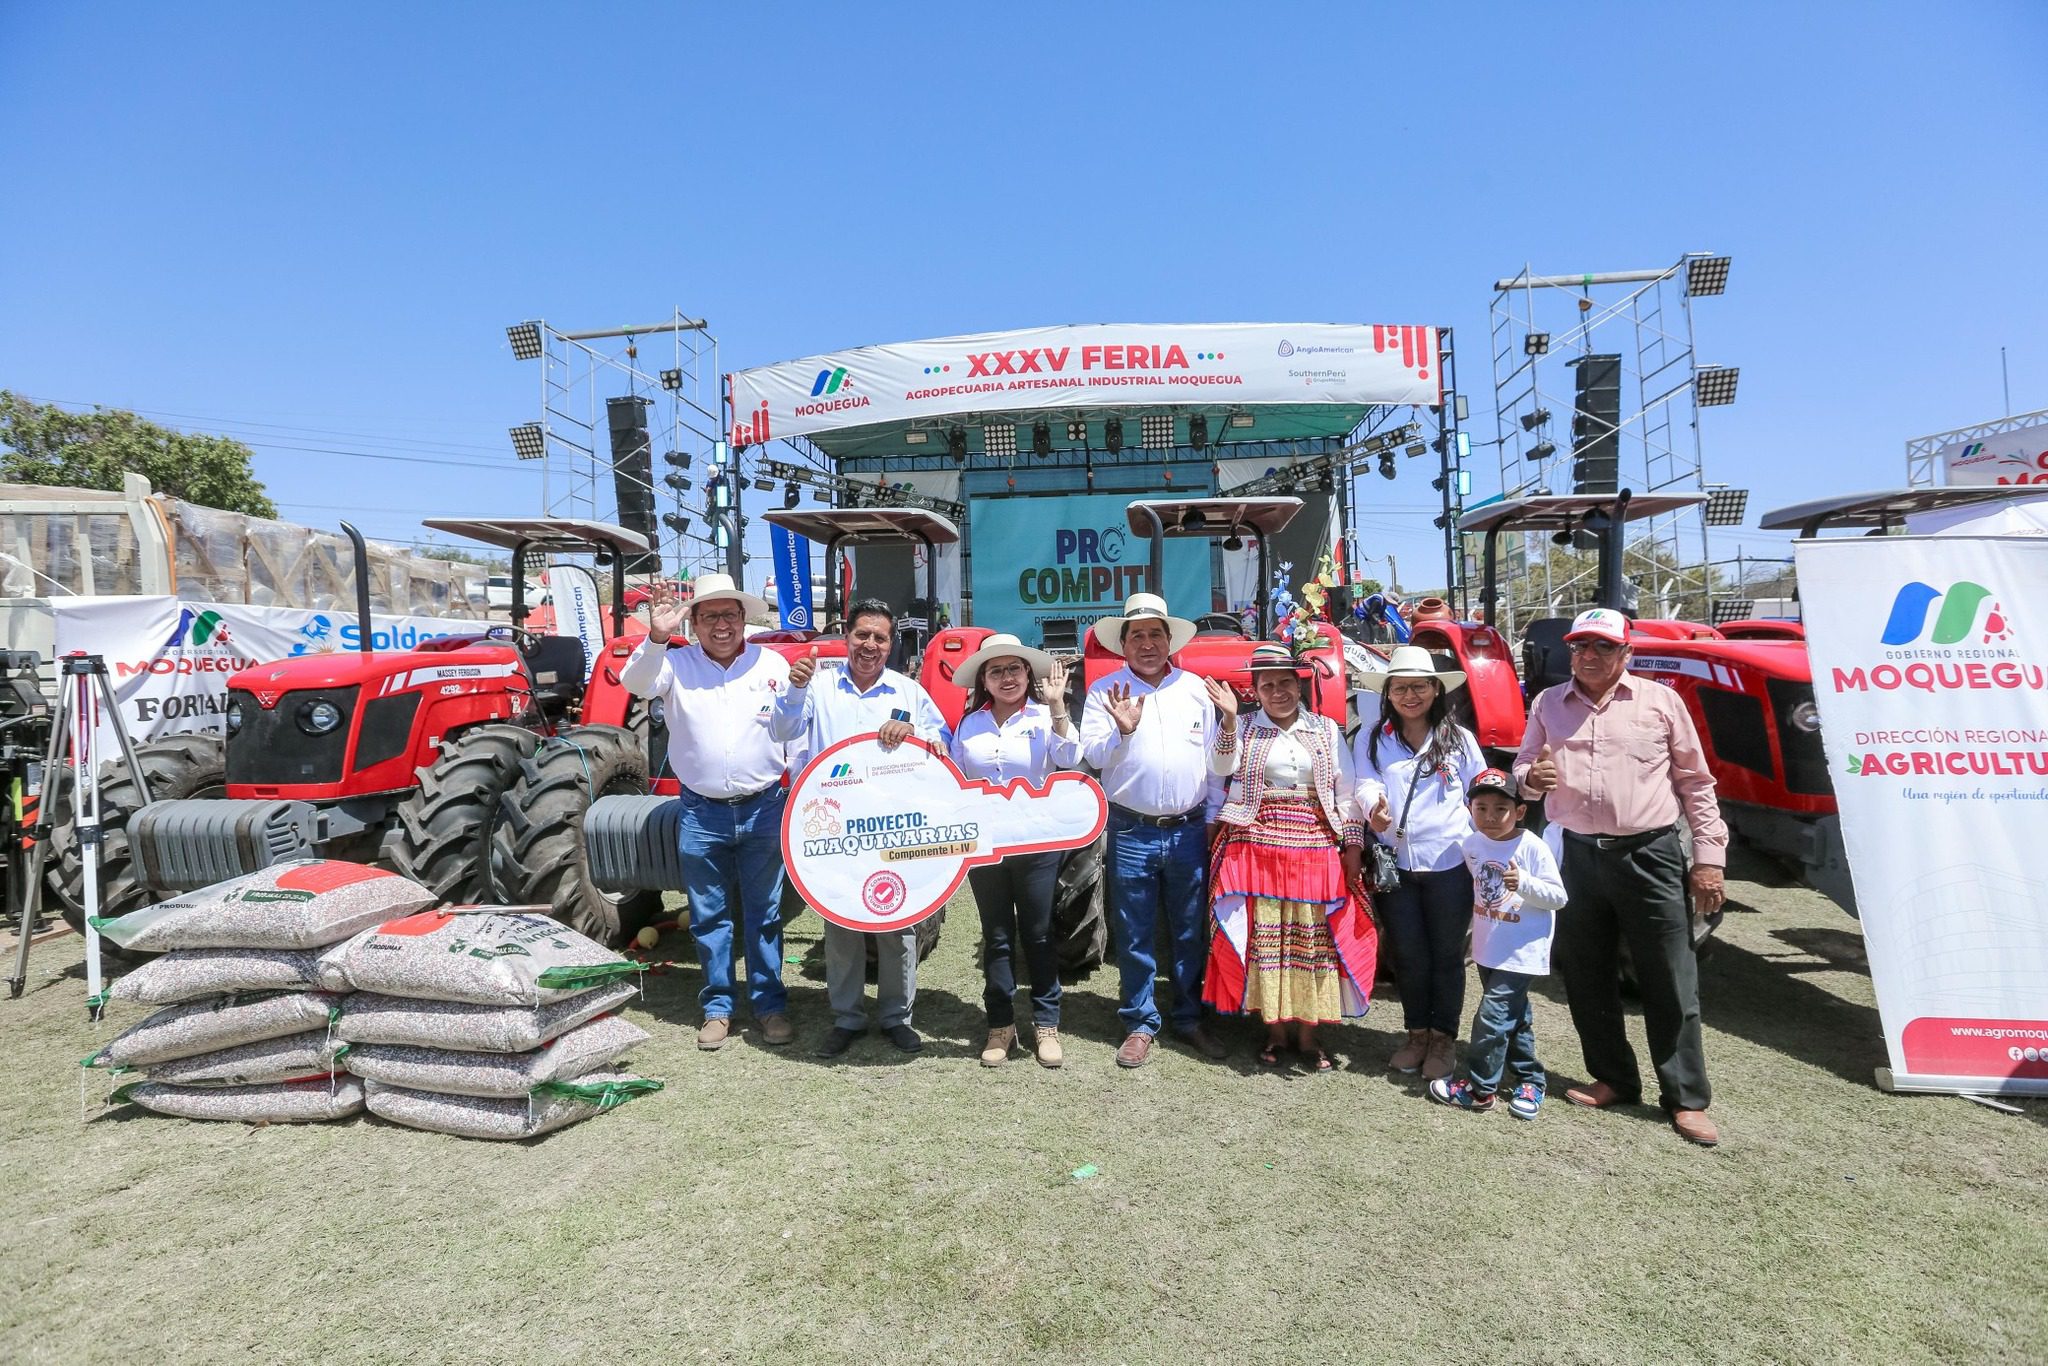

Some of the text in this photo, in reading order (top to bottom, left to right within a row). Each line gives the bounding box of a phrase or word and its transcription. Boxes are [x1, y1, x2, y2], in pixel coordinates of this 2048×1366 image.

[1297, 346, 1354, 355] AngloAmerican
[967, 344, 1190, 377] XXXV FERIA
[1289, 369, 1346, 378] SouthernPerú
[906, 374, 1242, 400] AGROPECUARIA ARTESANAL INDUSTRIAL MOQUEGUA
[795, 397, 870, 416] MOQUEGUA
[1633, 658, 1654, 669] MASSEY
[1886, 650, 1952, 660] GOBIERNO
[115, 657, 259, 678] MOQUEGUA
[436, 669, 457, 678] MASSEY
[1831, 662, 2048, 694] MOQUEGU
[1855, 727, 1960, 746] DIRECCIÓN
[1860, 751, 2048, 777] AGRICULTU
[821, 778, 863, 788] MOQUEGUA
[1902, 787, 1929, 800] Una
[1972, 787, 1985, 800] de
[846, 811, 928, 834] PROYECTO:
[803, 823, 979, 857] MAQUINARIAS
[889, 846, 948, 861] Componente
